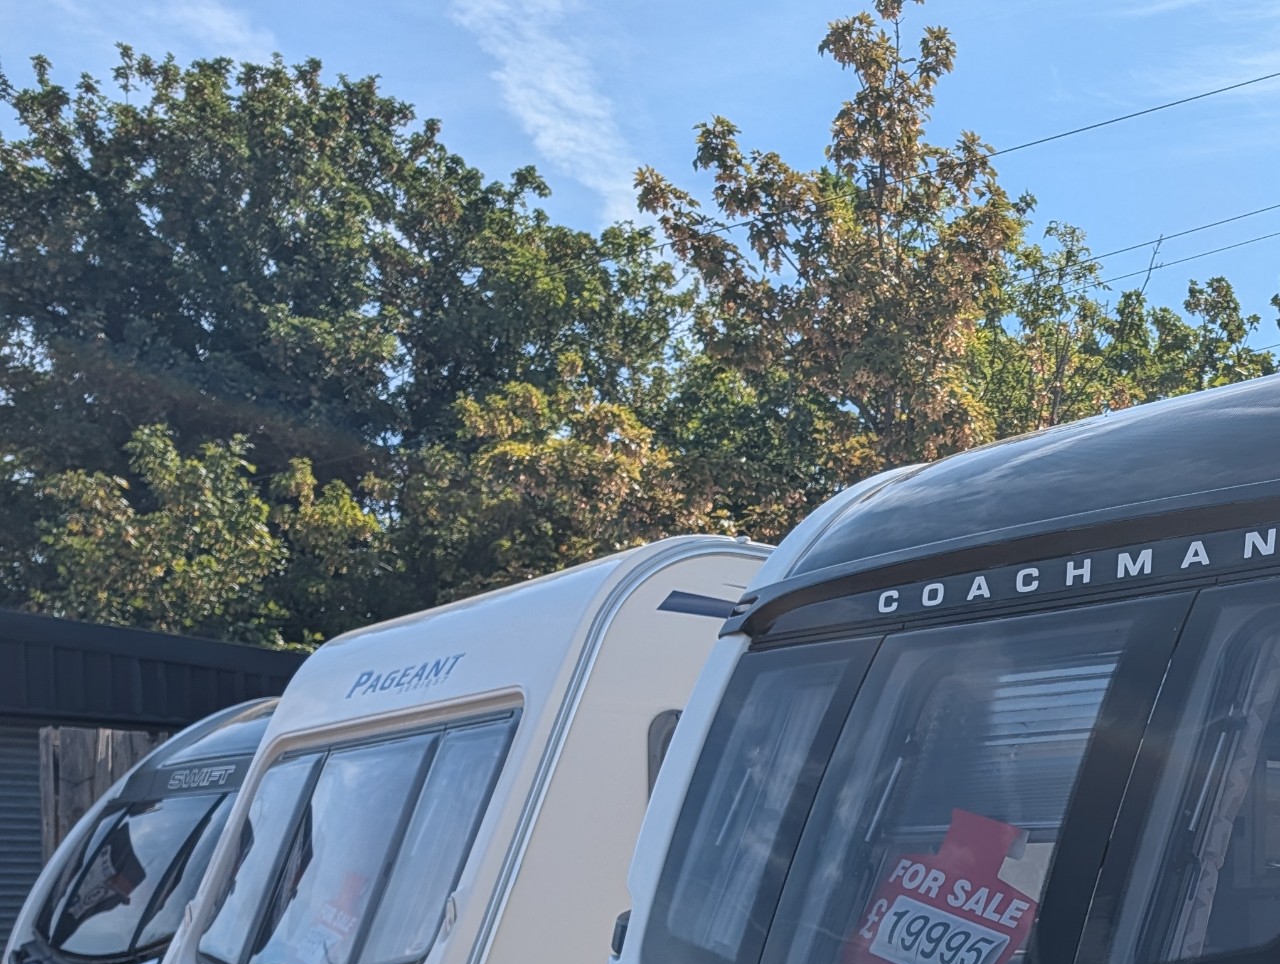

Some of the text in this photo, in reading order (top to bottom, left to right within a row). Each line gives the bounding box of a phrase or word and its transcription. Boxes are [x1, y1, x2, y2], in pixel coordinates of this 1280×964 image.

[878, 528, 1277, 613] COACHMAN
[345, 652, 466, 699] PAGEANT
[167, 765, 236, 789] SWIFT
[888, 859, 1030, 928] FOR SALE
[859, 898, 888, 939] £
